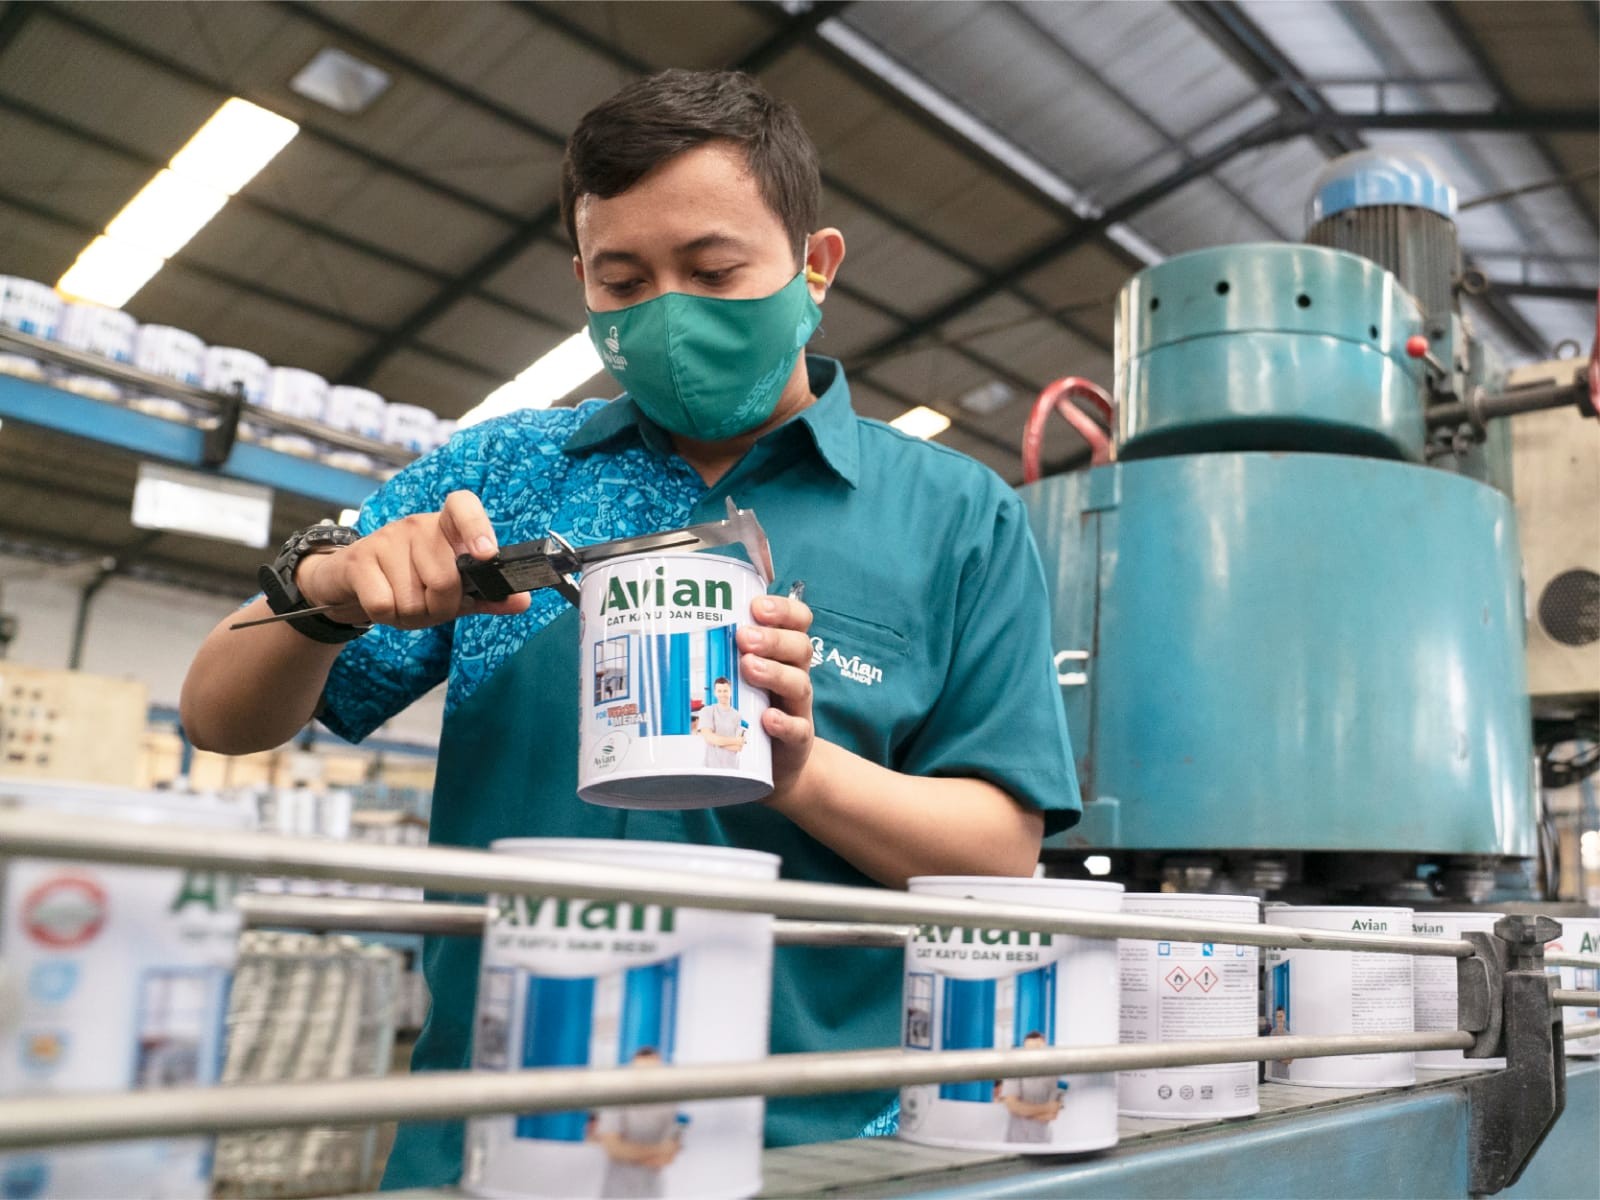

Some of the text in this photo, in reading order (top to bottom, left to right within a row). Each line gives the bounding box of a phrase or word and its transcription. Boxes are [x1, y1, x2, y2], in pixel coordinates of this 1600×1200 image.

[600, 566, 732, 616] Avian
[607, 614, 627, 626] CAT
[696, 611, 723, 622] BESI
[826, 648, 883, 683] Avian
[1352, 918, 1387, 931] Avian
[1412, 922, 1443, 934] Avian
[936, 949, 968, 960] KAYU
[972, 951, 1000, 961] DAN
[1006, 951, 1039, 962] BESI
